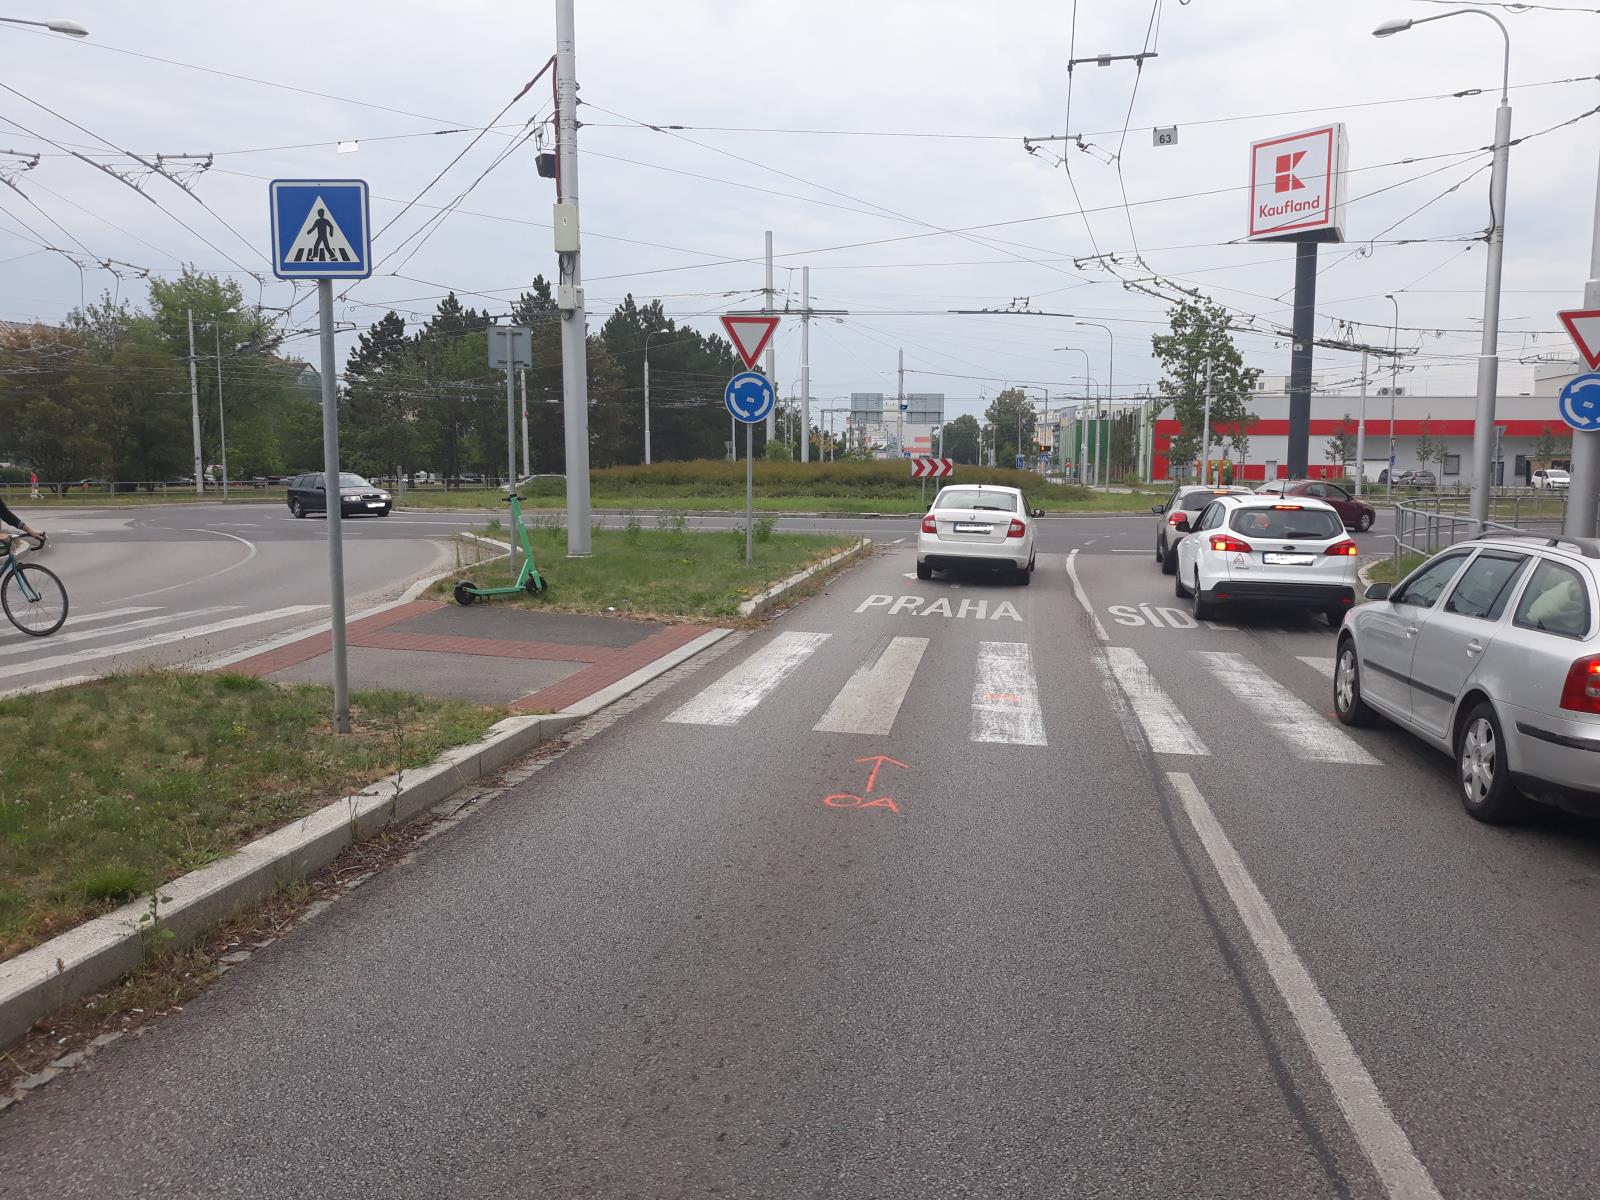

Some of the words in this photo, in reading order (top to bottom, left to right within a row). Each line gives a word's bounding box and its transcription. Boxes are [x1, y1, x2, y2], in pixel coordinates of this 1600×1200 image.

[1159, 134, 1171, 144] 63
[1275, 150, 1308, 193] K
[1259, 195, 1320, 218] Kaufland
[854, 594, 1023, 622] PRAHA
